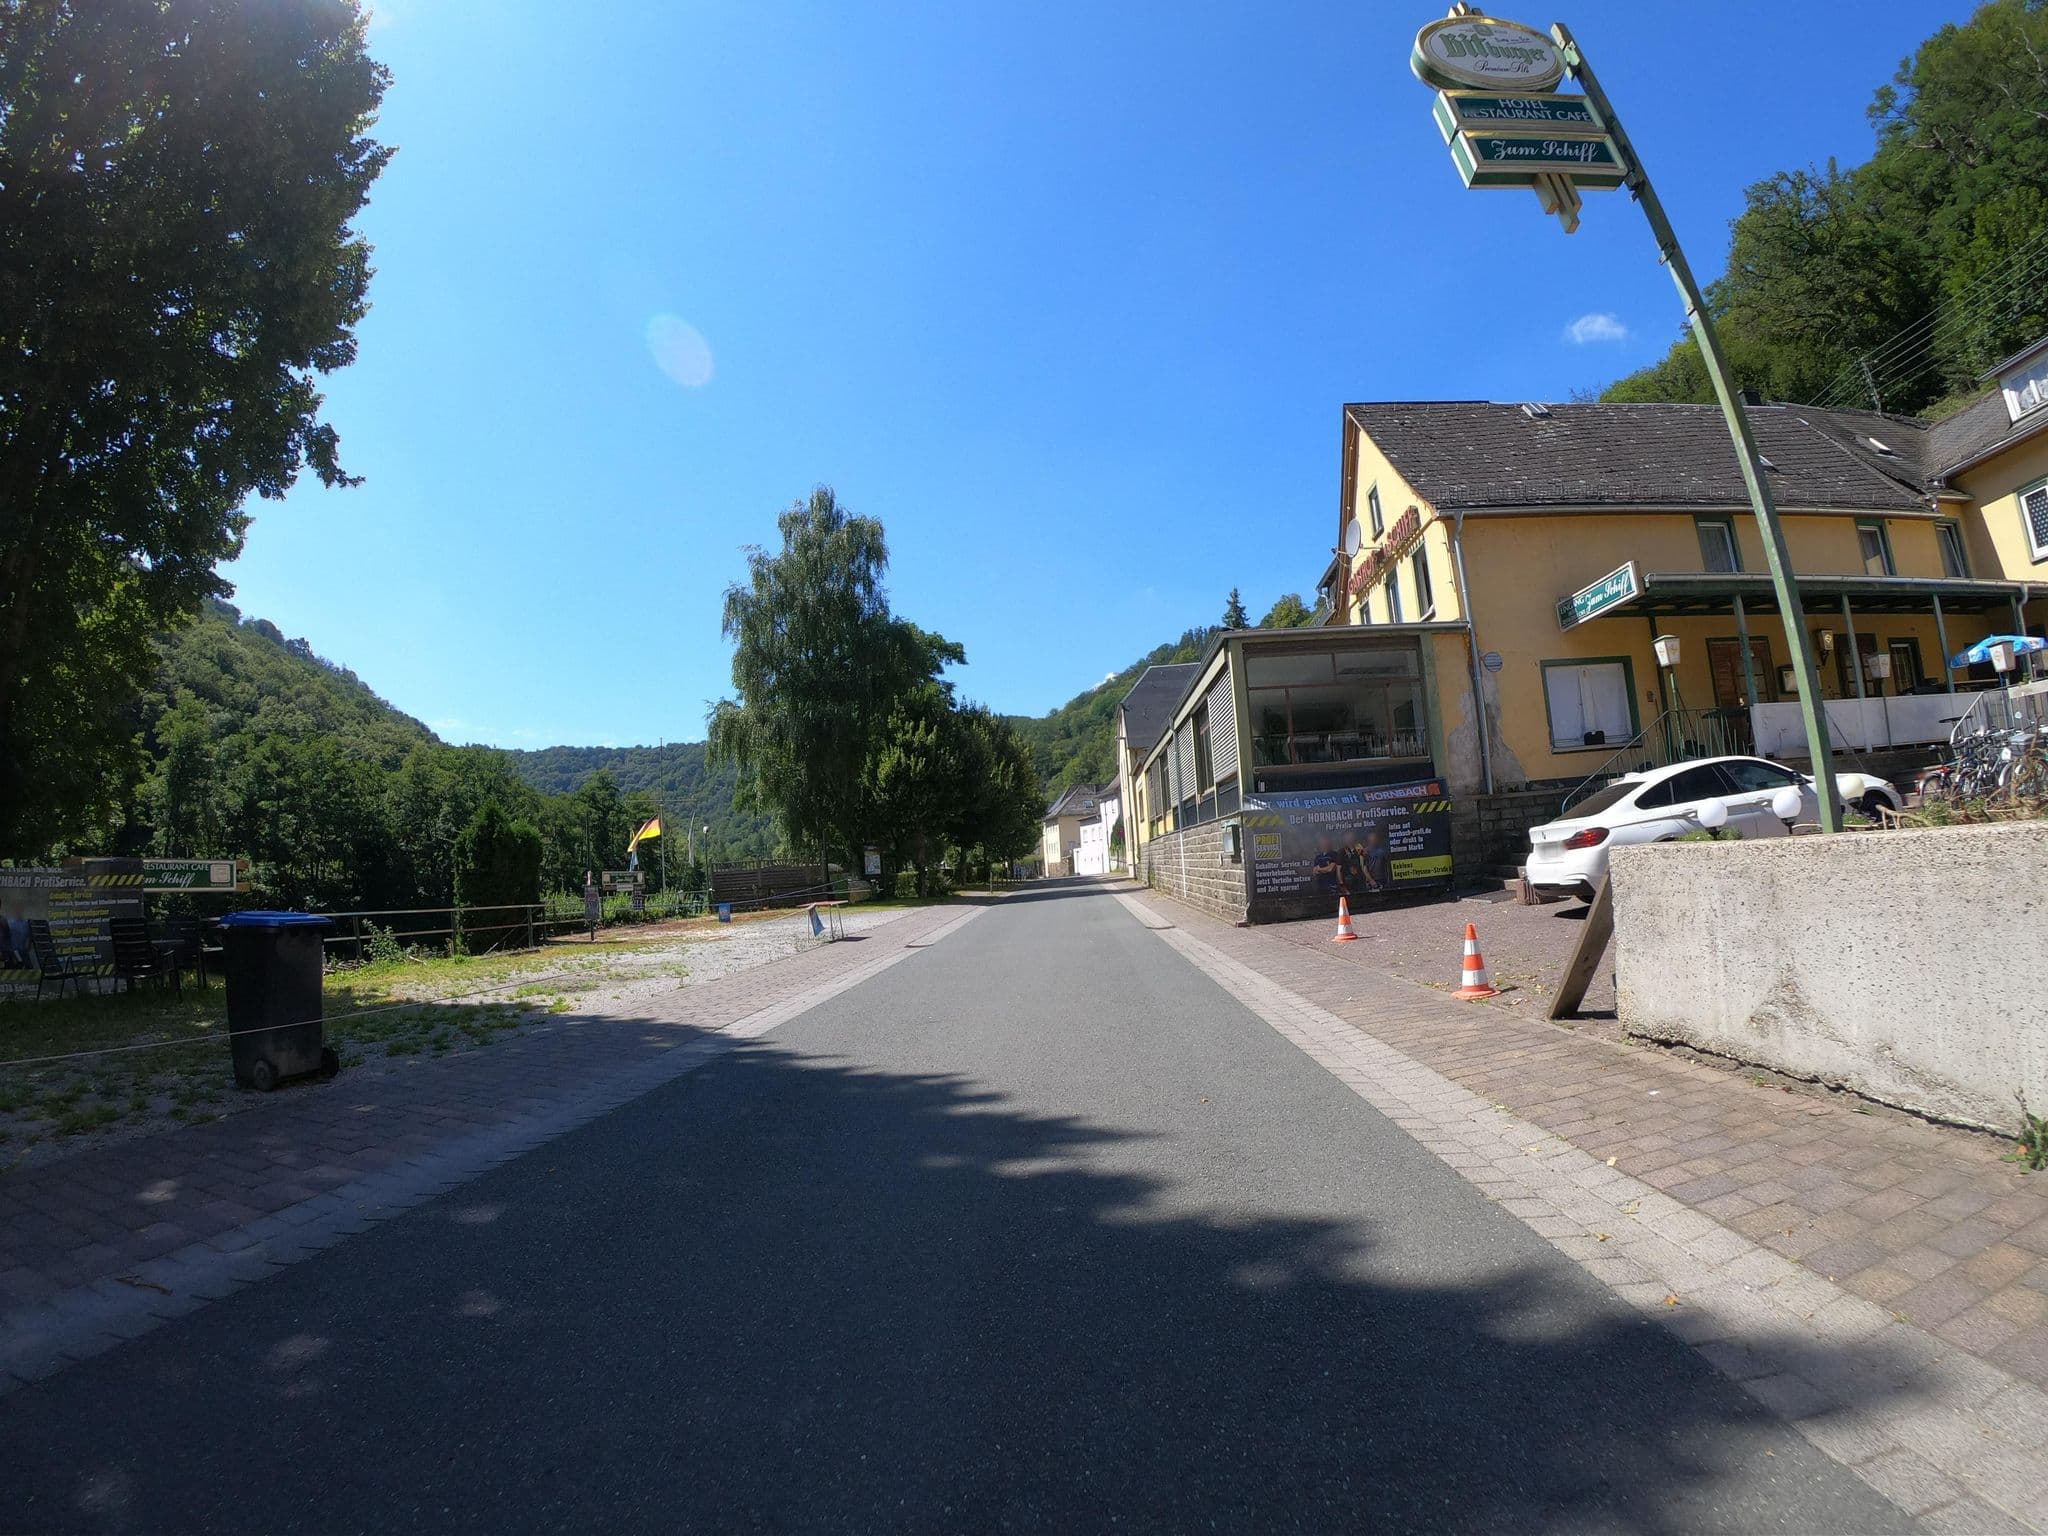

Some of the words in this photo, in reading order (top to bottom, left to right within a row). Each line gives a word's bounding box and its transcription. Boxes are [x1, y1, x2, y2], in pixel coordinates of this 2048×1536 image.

[1438, 33, 1548, 65] Bitburger
[1473, 60, 1510, 72] Premium
[1510, 61, 1530, 73] Pils
[1463, 107, 1553, 120] RESTAURANT
[1498, 98, 1549, 110] HOTEL
[1490, 139, 1540, 160] Zum
[1541, 140, 1599, 162] Schiff
[1584, 592, 1604, 614] Zum
[1604, 571, 1630, 598] Schiff
[1275, 798, 1300, 809] wird
[1303, 795, 1338, 809] gebaut
[1341, 794, 1360, 804] mit
[1364, 785, 1428, 802] HORNBACH
[1289, 814, 1305, 825] Der
[1307, 809, 1353, 823] HORNBACH
[1355, 804, 1410, 820] ProfiService.
[34, 875, 87, 888] ProfiService.
[158, 871, 197, 888] Schiff
